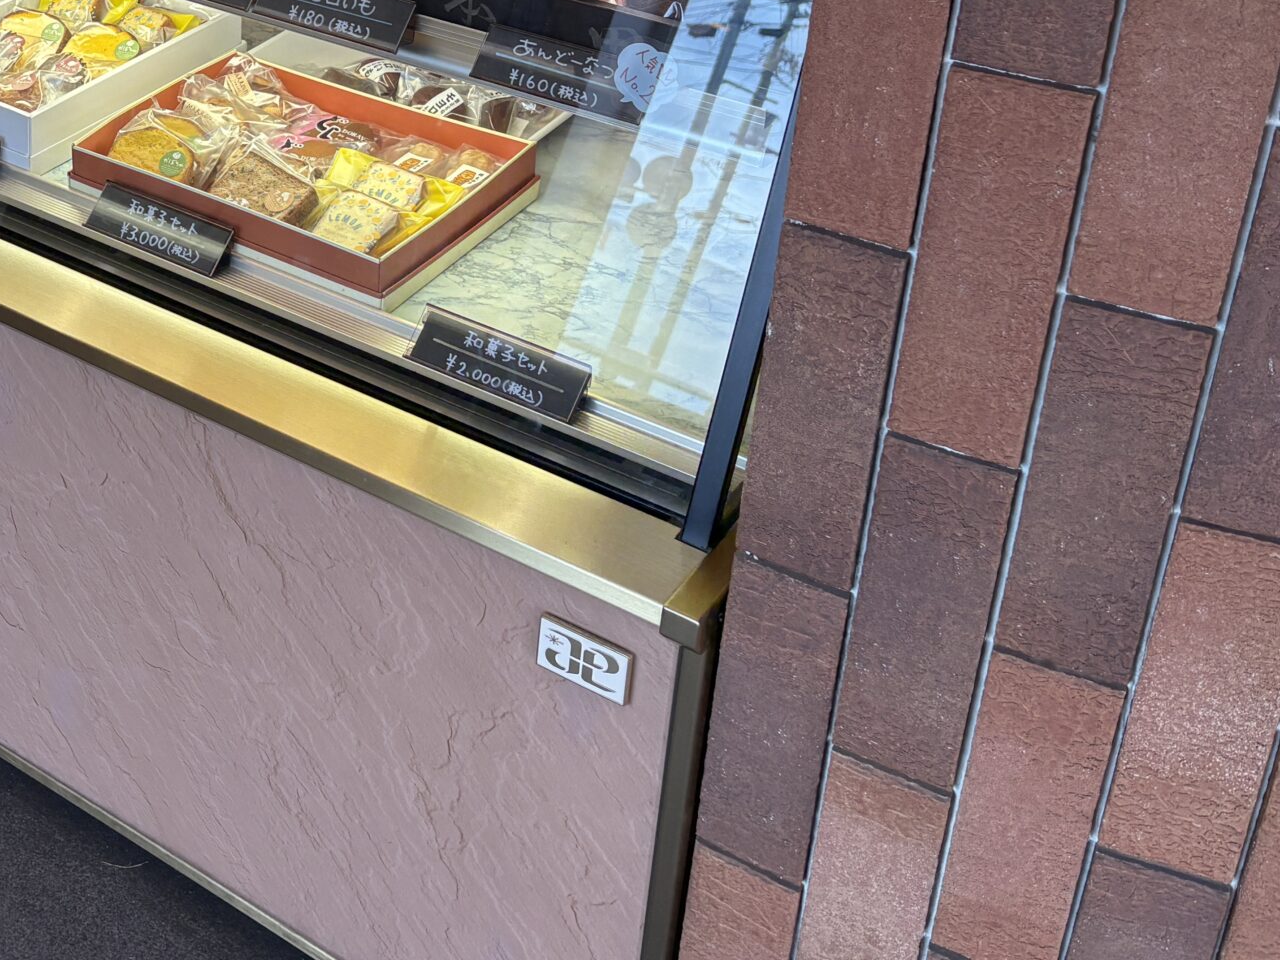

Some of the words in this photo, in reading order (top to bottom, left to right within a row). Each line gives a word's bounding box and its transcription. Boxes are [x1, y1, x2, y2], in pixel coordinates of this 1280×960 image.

[288, 4, 370, 40] ¥180(税込)
[513, 39, 614, 80] あんどーなつ
[509, 68, 598, 108] ¥160(税込)
[127, 198, 200, 236] 和菓子セット
[328, 214, 363, 231] LEMON
[463, 330, 548, 376] 和菓子セット
